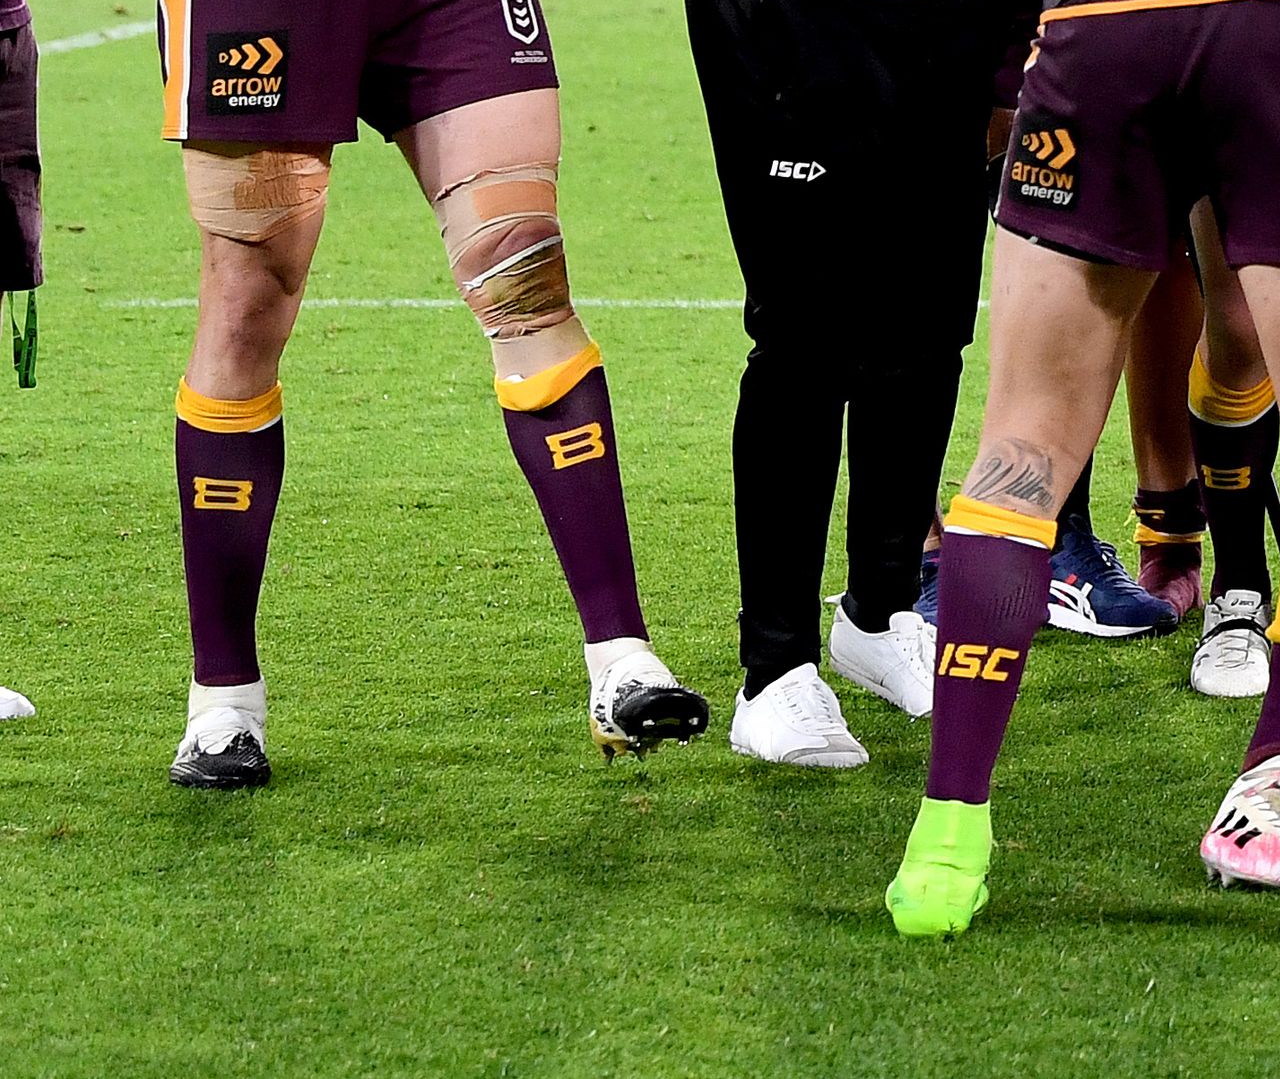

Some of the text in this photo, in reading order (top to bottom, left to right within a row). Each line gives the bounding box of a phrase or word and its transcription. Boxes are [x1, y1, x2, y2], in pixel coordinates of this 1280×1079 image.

[211, 76, 283, 97] arrow
[228, 93, 281, 108] energy
[769, 159, 811, 180] ISC
[1011, 160, 1075, 191] arrow
[1021, 181, 1074, 206] energy
[545, 422, 607, 470] B
[1200, 465, 1251, 490] B
[192, 476, 254, 512] B
[937, 642, 1020, 682] ISC
